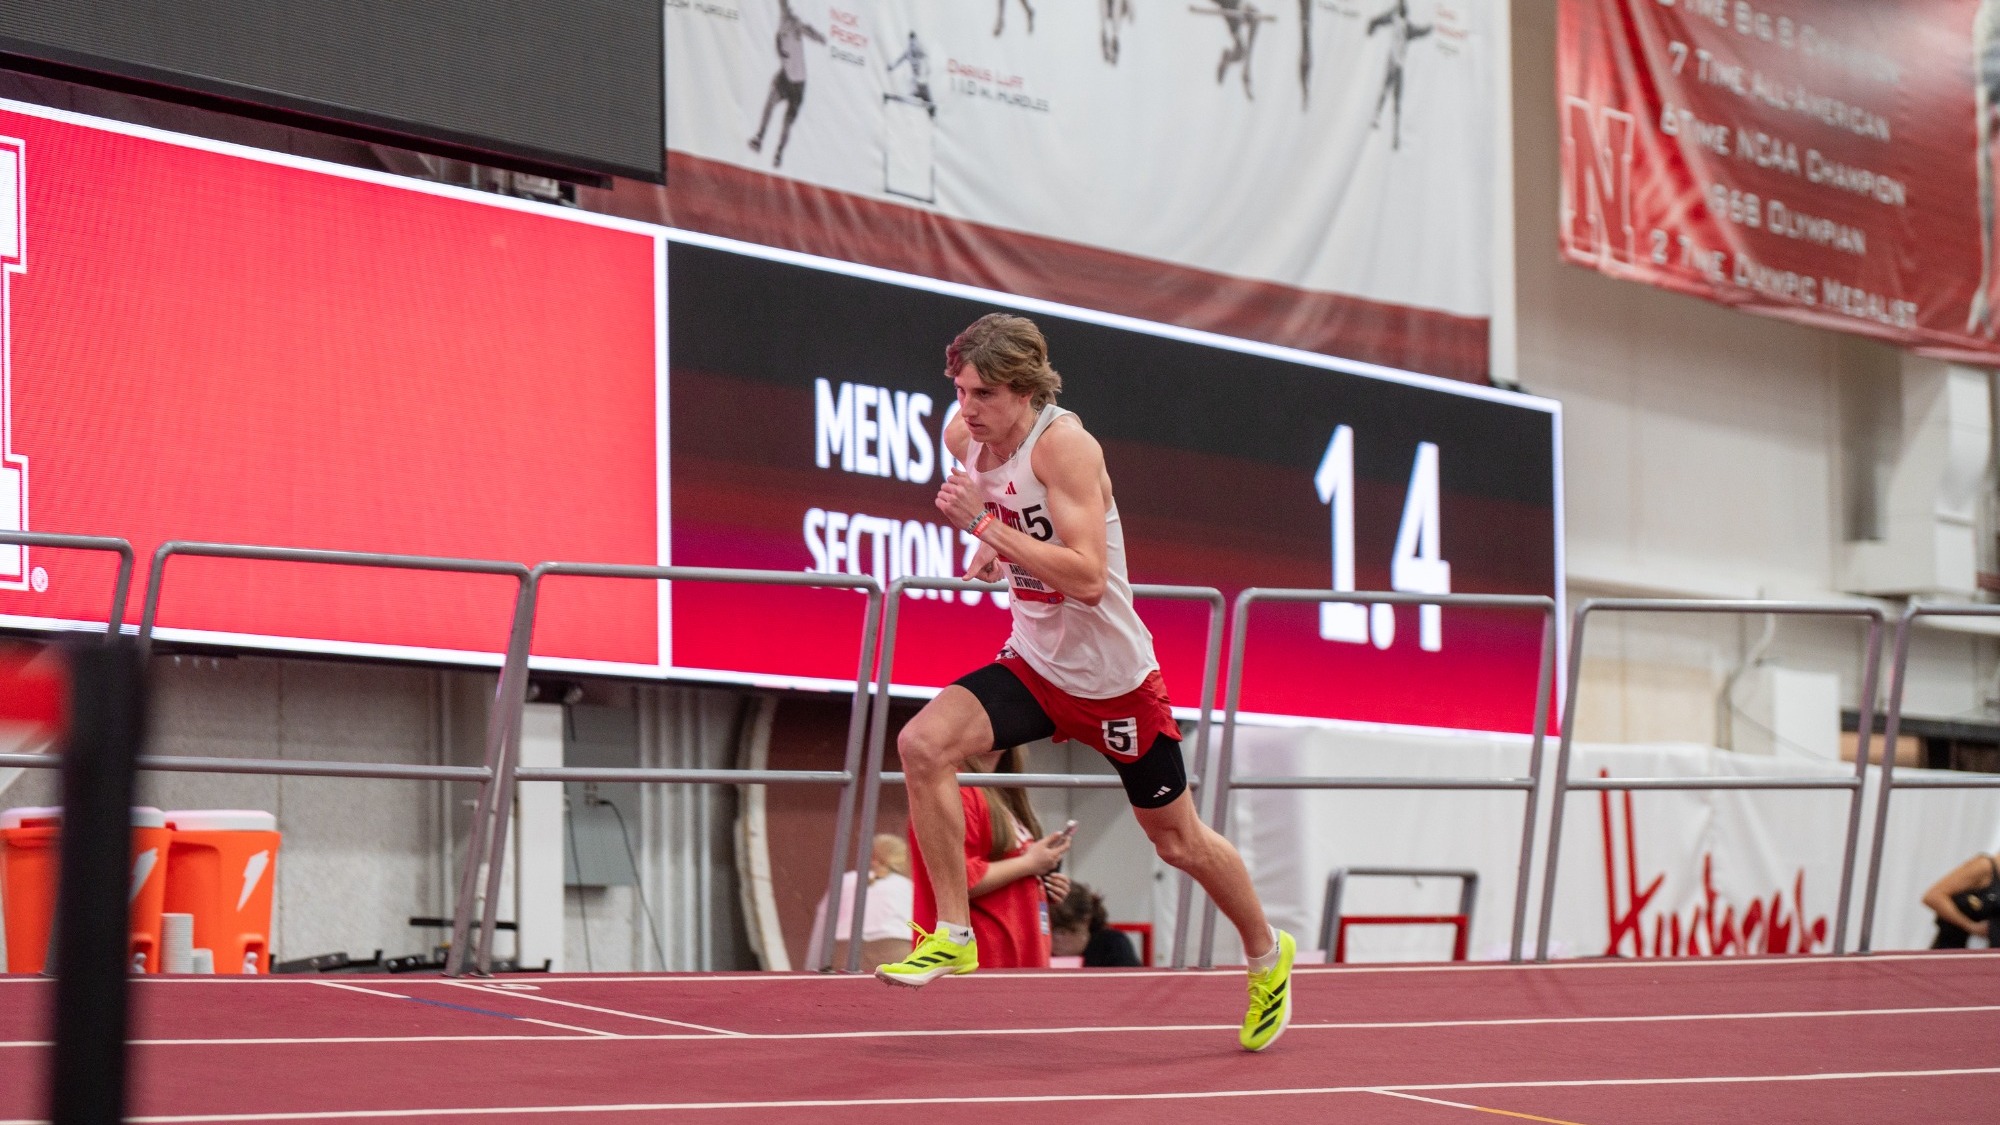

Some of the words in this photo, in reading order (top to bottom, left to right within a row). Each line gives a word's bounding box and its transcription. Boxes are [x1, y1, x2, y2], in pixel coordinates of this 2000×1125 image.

[1668, 40, 1688, 76] 7
[1735, 127, 1800, 174] NCAA
[1806, 148, 1908, 208] CHAMPION
[1767, 200, 1867, 256] OLYMPIAN
[1652, 228, 1668, 265] 2
[1678, 234, 1727, 283] TIME
[1733, 252, 1818, 306] OLYMPIC
[1822, 277, 1919, 329] MEDALIST
[814, 377, 935, 484] MENS
[803, 507, 954, 604] SECTION
[1021, 503, 1054, 542] 5
[1313, 423, 1451, 652] 1.4
[1014, 576, 1045, 591] ATWOOD
[1107, 720, 1132, 752] 5
